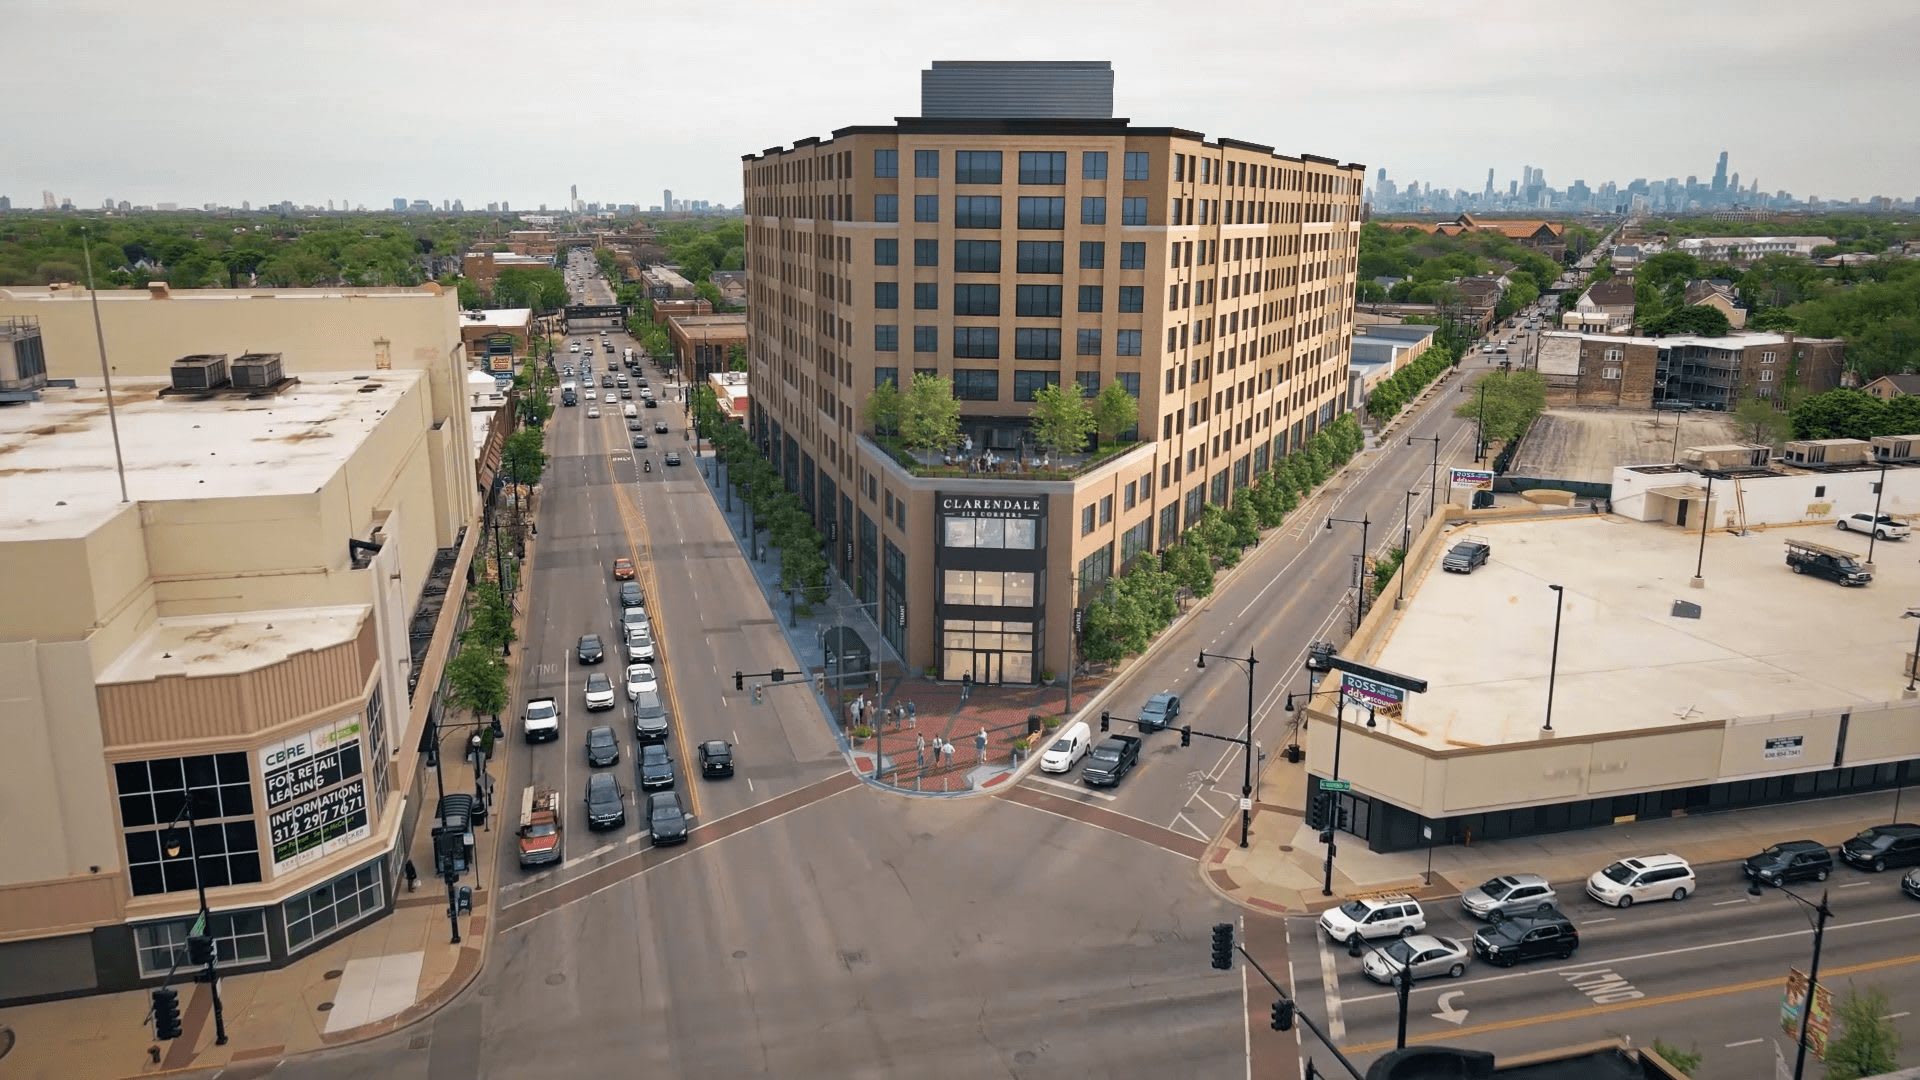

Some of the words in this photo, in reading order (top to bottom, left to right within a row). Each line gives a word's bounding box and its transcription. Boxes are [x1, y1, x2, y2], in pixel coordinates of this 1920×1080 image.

[943, 499, 1040, 510] CLARENDALE
[1347, 676, 1376, 693] ROSS
[265, 743, 306, 767] CBRE
[268, 772, 295, 792] FOR
[298, 756, 337, 779] RETAIL
[270, 775, 325, 805] LEASING
[272, 783, 362, 828] INFORMATION:
[274, 822, 301, 844] 312
[304, 810, 328, 831] 297
[1558, 968, 1646, 1004] ONLY
